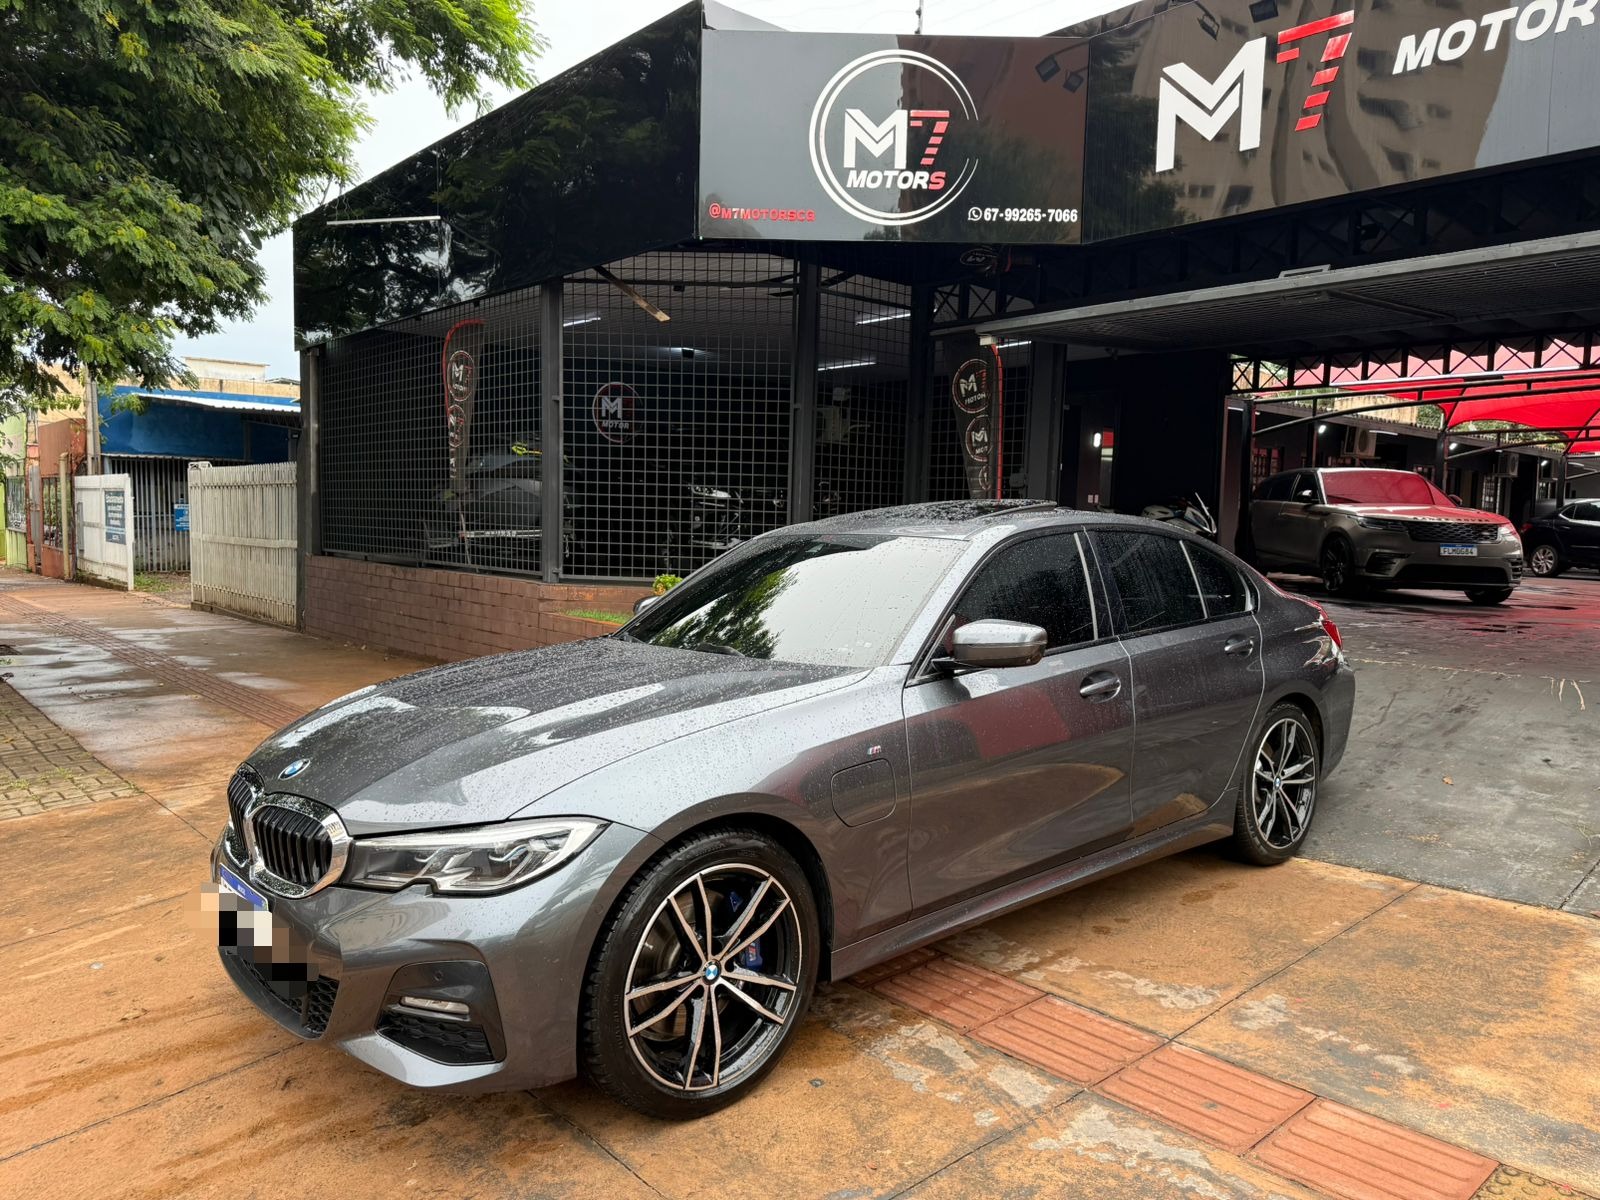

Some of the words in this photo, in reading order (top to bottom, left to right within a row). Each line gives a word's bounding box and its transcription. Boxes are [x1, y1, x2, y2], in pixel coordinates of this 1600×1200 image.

[1156, 10, 1354, 172] M7
[844, 109, 949, 169] M7
[846, 170, 946, 190] MOTORS
[709, 203, 815, 222] @M7MOTORSCG
[983, 208, 1078, 222] 67-99265-7066
